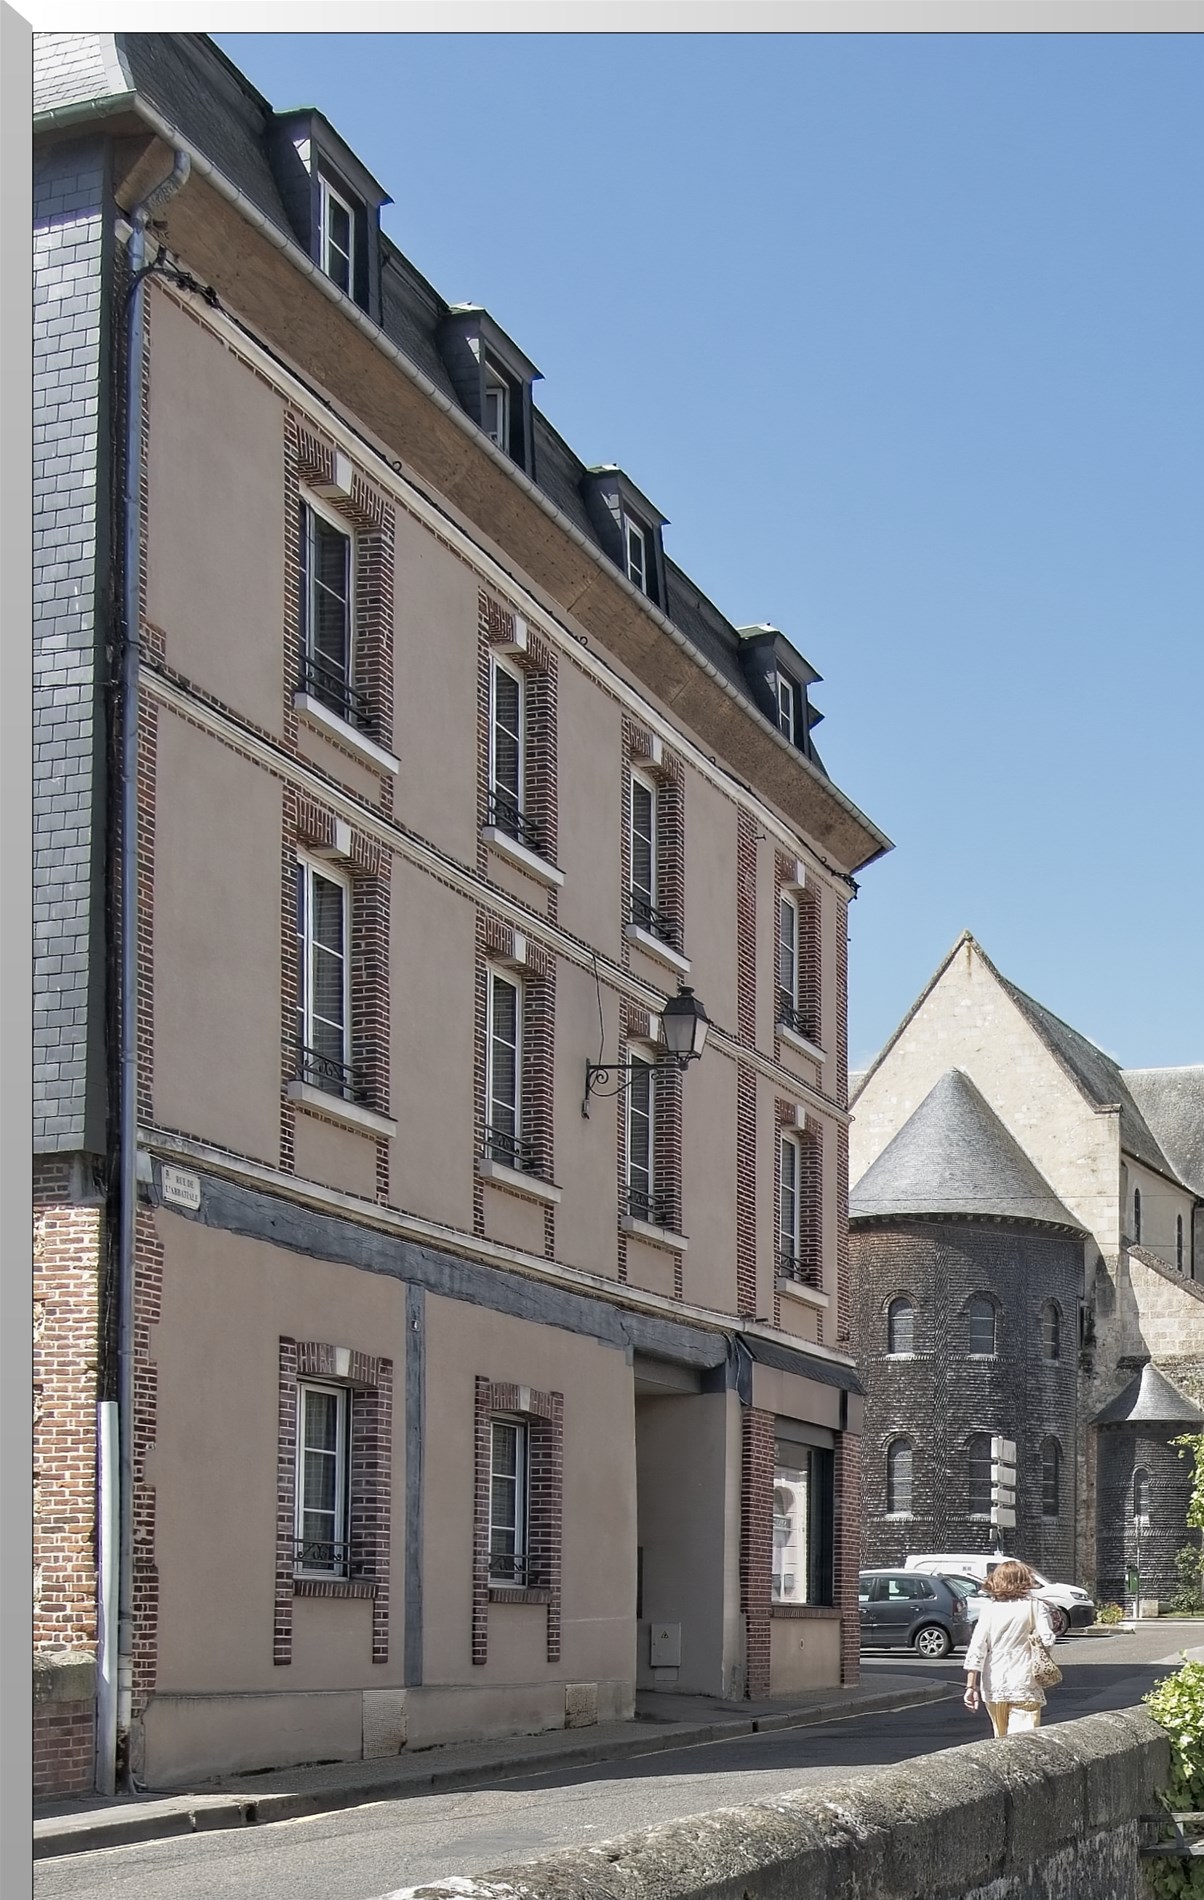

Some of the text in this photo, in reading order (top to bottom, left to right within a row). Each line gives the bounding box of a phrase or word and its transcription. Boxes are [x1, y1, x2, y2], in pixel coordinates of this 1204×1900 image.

[176, 1176, 194, 1189] RUE DE
[165, 1185, 199, 1202] L'ABBATIALE
